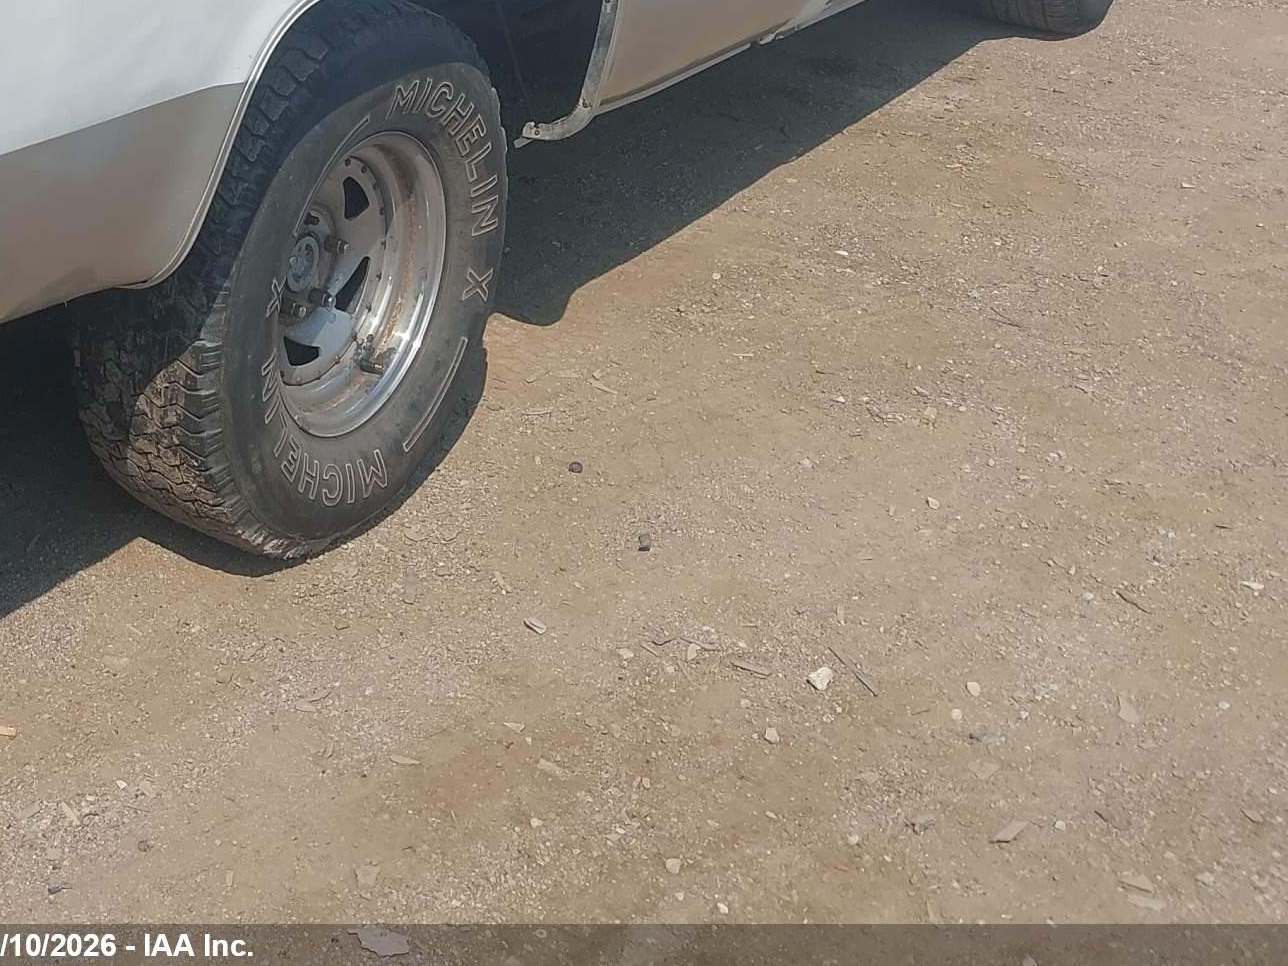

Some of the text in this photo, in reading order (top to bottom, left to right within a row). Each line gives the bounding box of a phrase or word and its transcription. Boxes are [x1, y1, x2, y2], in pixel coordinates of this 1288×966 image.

[384, 76, 499, 303] MICHELIN X
[262, 347, 389, 508] MICHELIN
